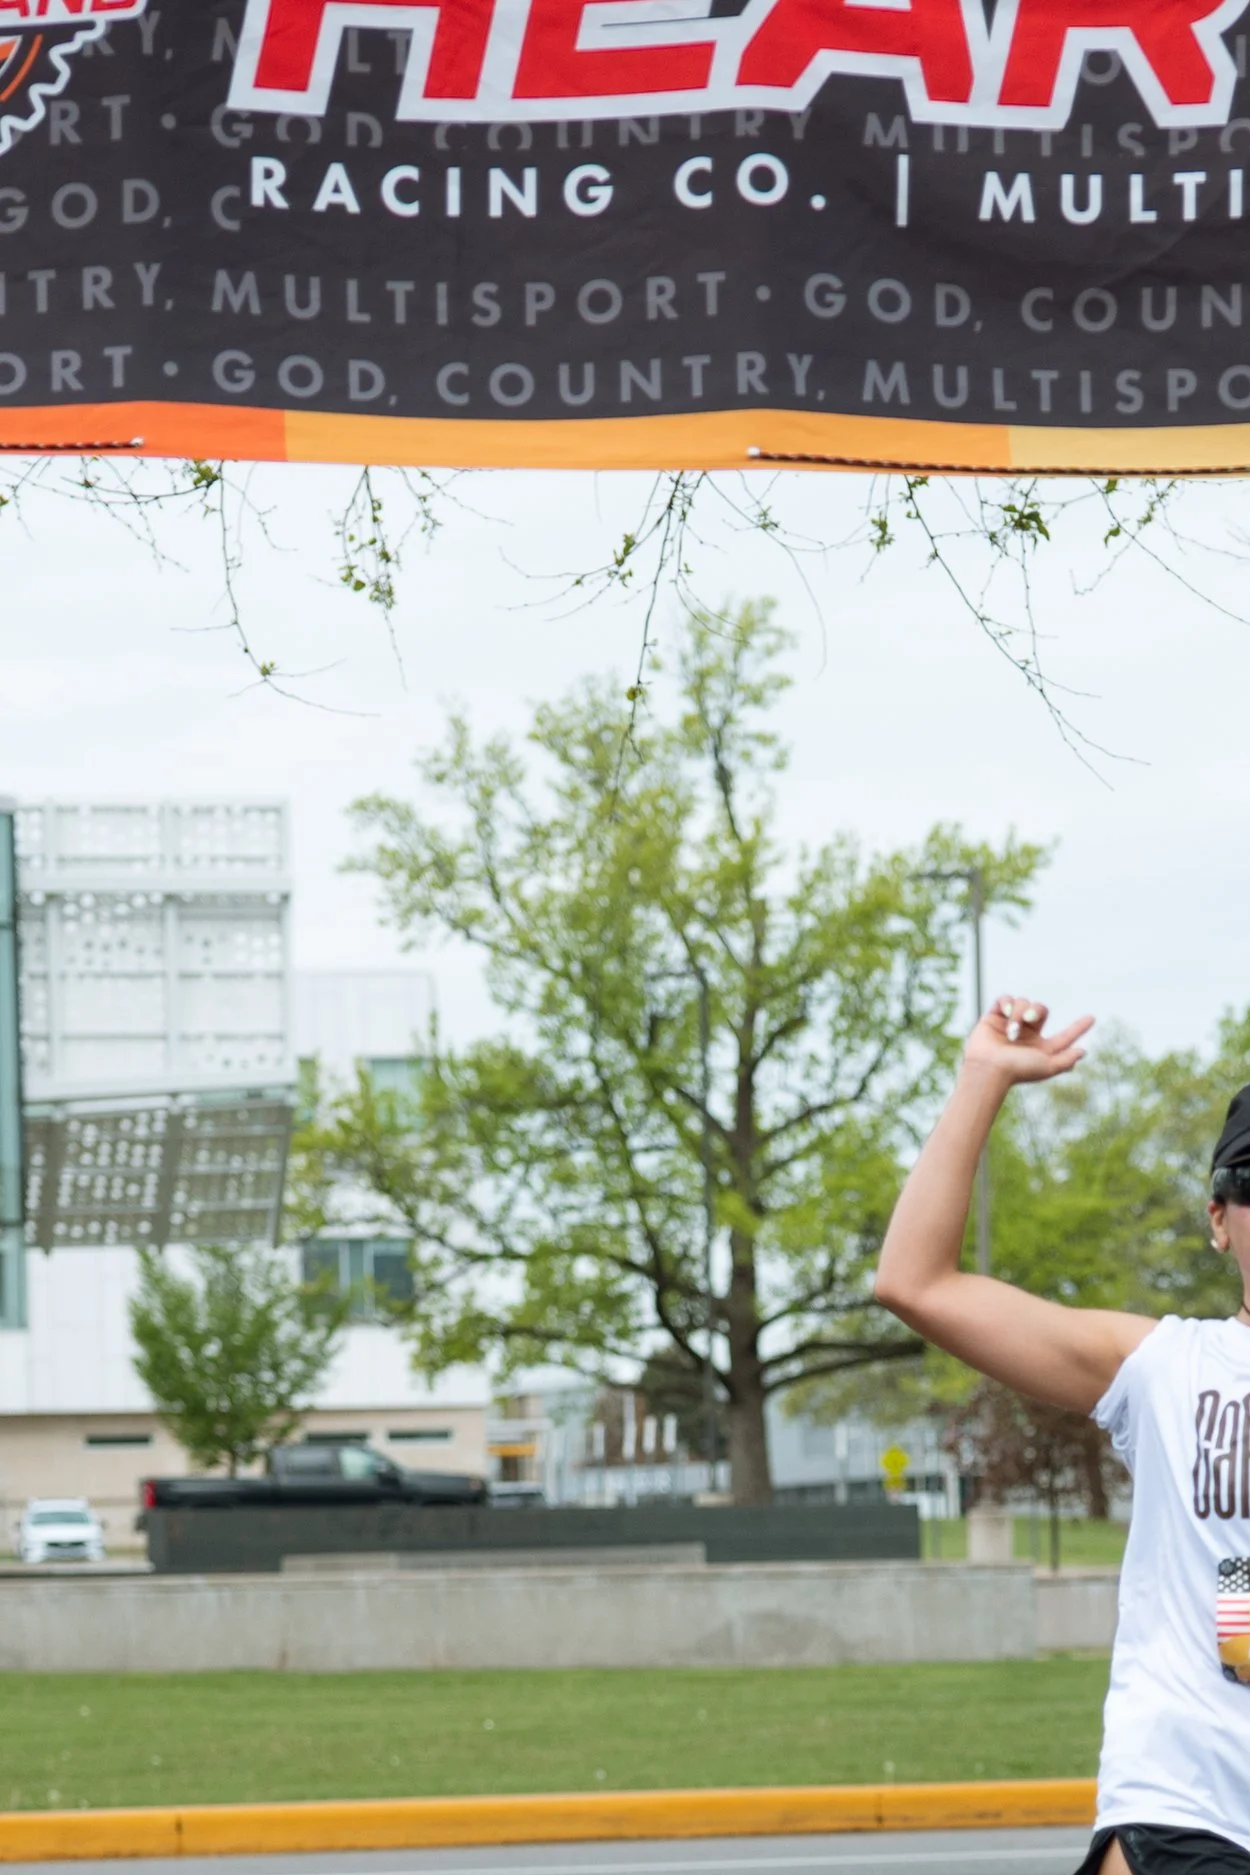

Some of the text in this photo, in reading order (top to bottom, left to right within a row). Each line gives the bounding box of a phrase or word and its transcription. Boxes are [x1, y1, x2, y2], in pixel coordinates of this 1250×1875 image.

[251, 156, 614, 218] RACING
[673, 153, 826, 210] CO.
[0, 262, 173, 316] TRY,
[211, 270, 726, 327] MULTISPORT
[804, 273, 982, 332] GOD,
[211, 350, 397, 406] GOD,
[436, 351, 825, 407] COUNTRY,
